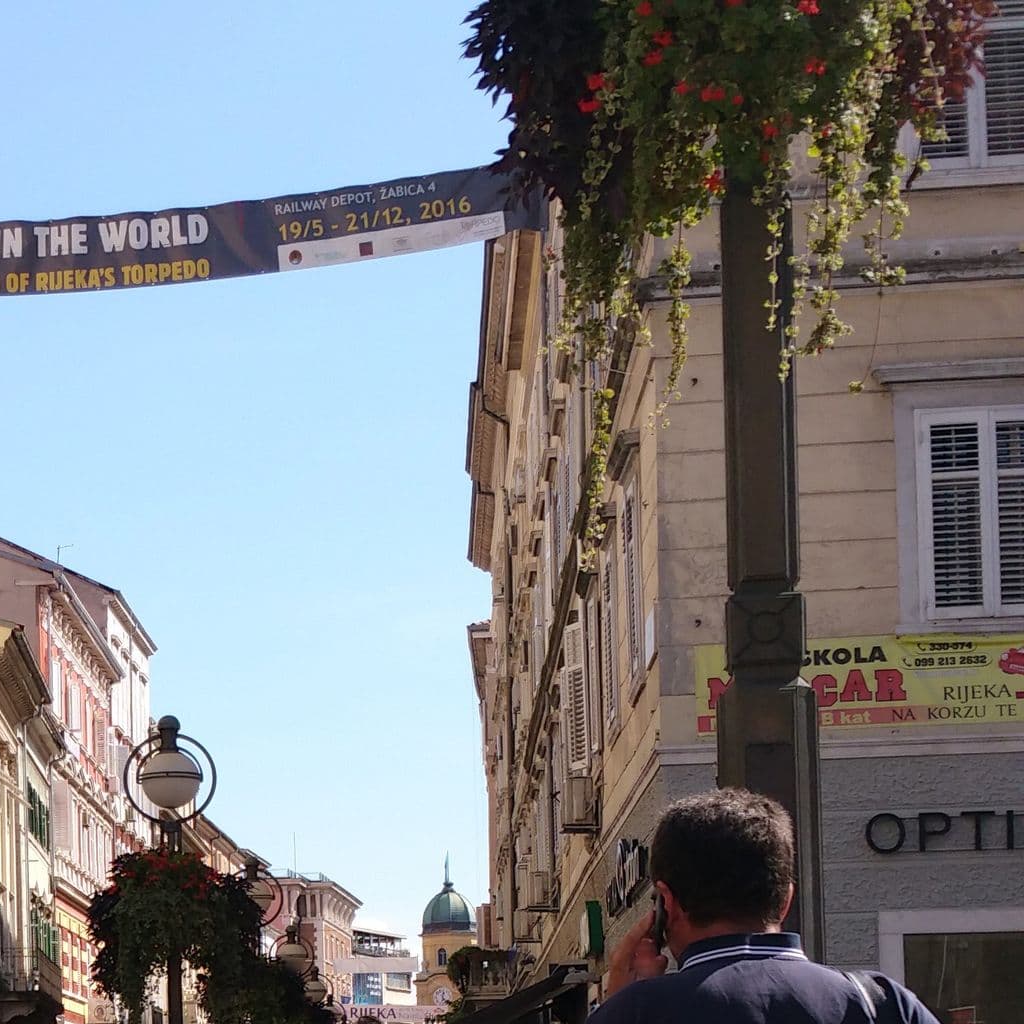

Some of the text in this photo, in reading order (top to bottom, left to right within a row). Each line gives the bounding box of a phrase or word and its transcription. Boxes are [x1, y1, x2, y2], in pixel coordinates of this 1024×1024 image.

[274, 182, 436, 216] RAILWAY DEPOT, ŽABICA 4
[33, 223, 89, 257] THE
[98, 213, 209, 253] WORLD
[278, 219, 324, 241] 19/5
[346, 207, 412, 231] 21/12,
[419, 196, 472, 221] 2016
[5, 272, 30, 293] OF
[35, 266, 116, 292] RIJEKA'S
[122, 258, 211, 285] TORPEDO
[915, 655, 987, 667] 099 213 2632
[944, 684, 1012, 703] RIJEKA
[841, 710, 871, 723] kat
[892, 708, 916, 720] NA
[928, 705, 986, 719] KORZU
[865, 810, 1014, 854] OPTI
